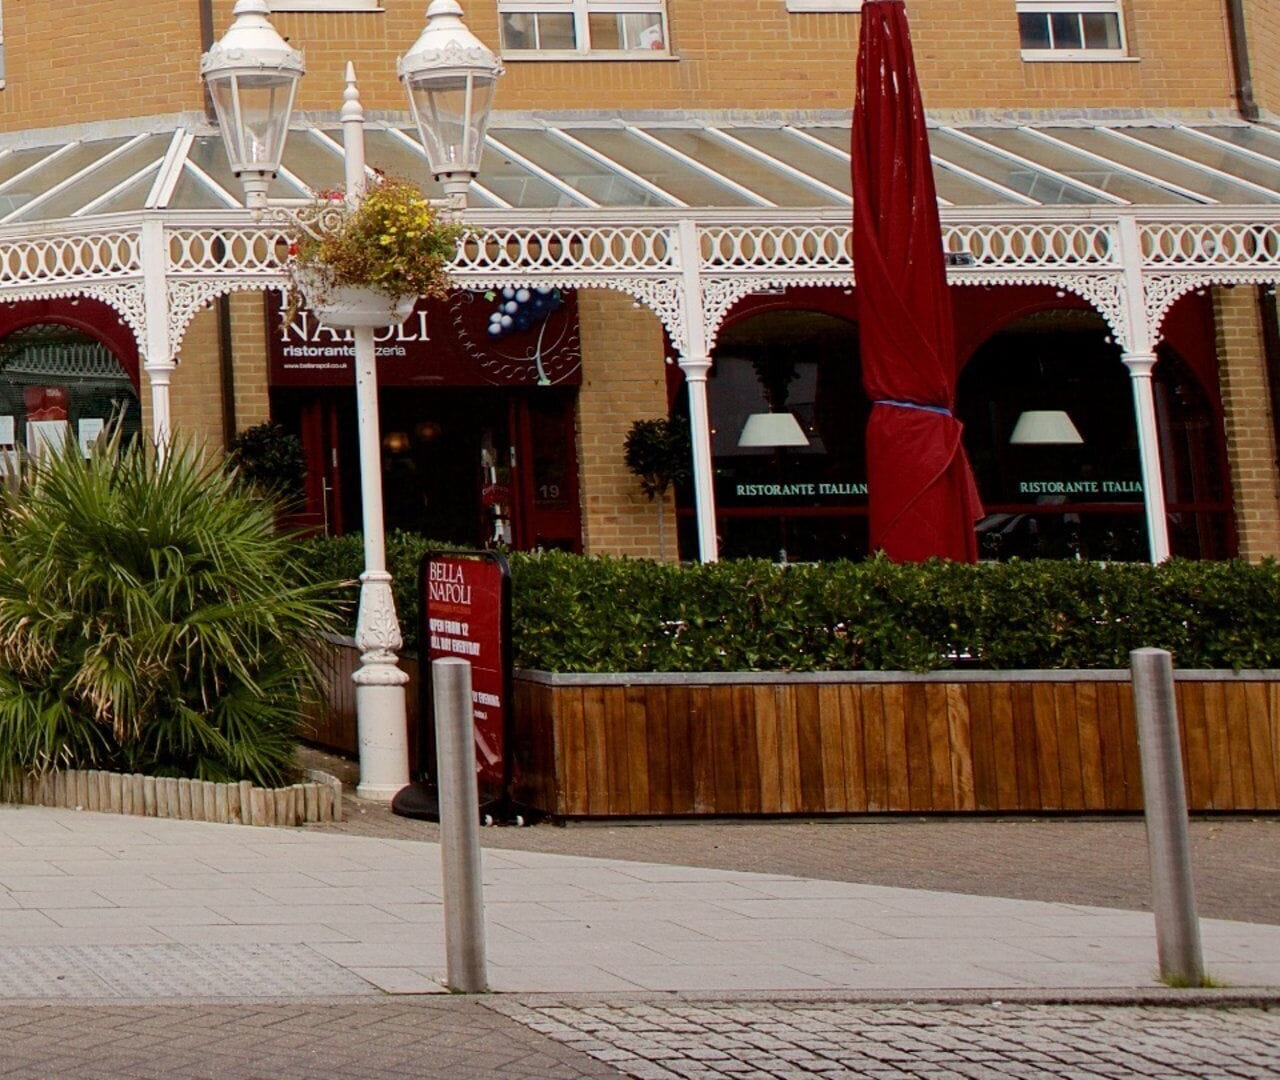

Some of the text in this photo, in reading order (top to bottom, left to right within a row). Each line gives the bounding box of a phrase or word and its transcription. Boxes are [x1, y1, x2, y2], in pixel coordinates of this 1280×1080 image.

[283, 344, 356, 357] ristorante
[539, 484, 560, 498] 19
[736, 483, 868, 495] RISTORANTE ITALIAN
[1019, 481, 1143, 493] RISTORANTE ITALIA
[430, 561, 464, 583] BELLA
[429, 581, 471, 605] NAPOLI
